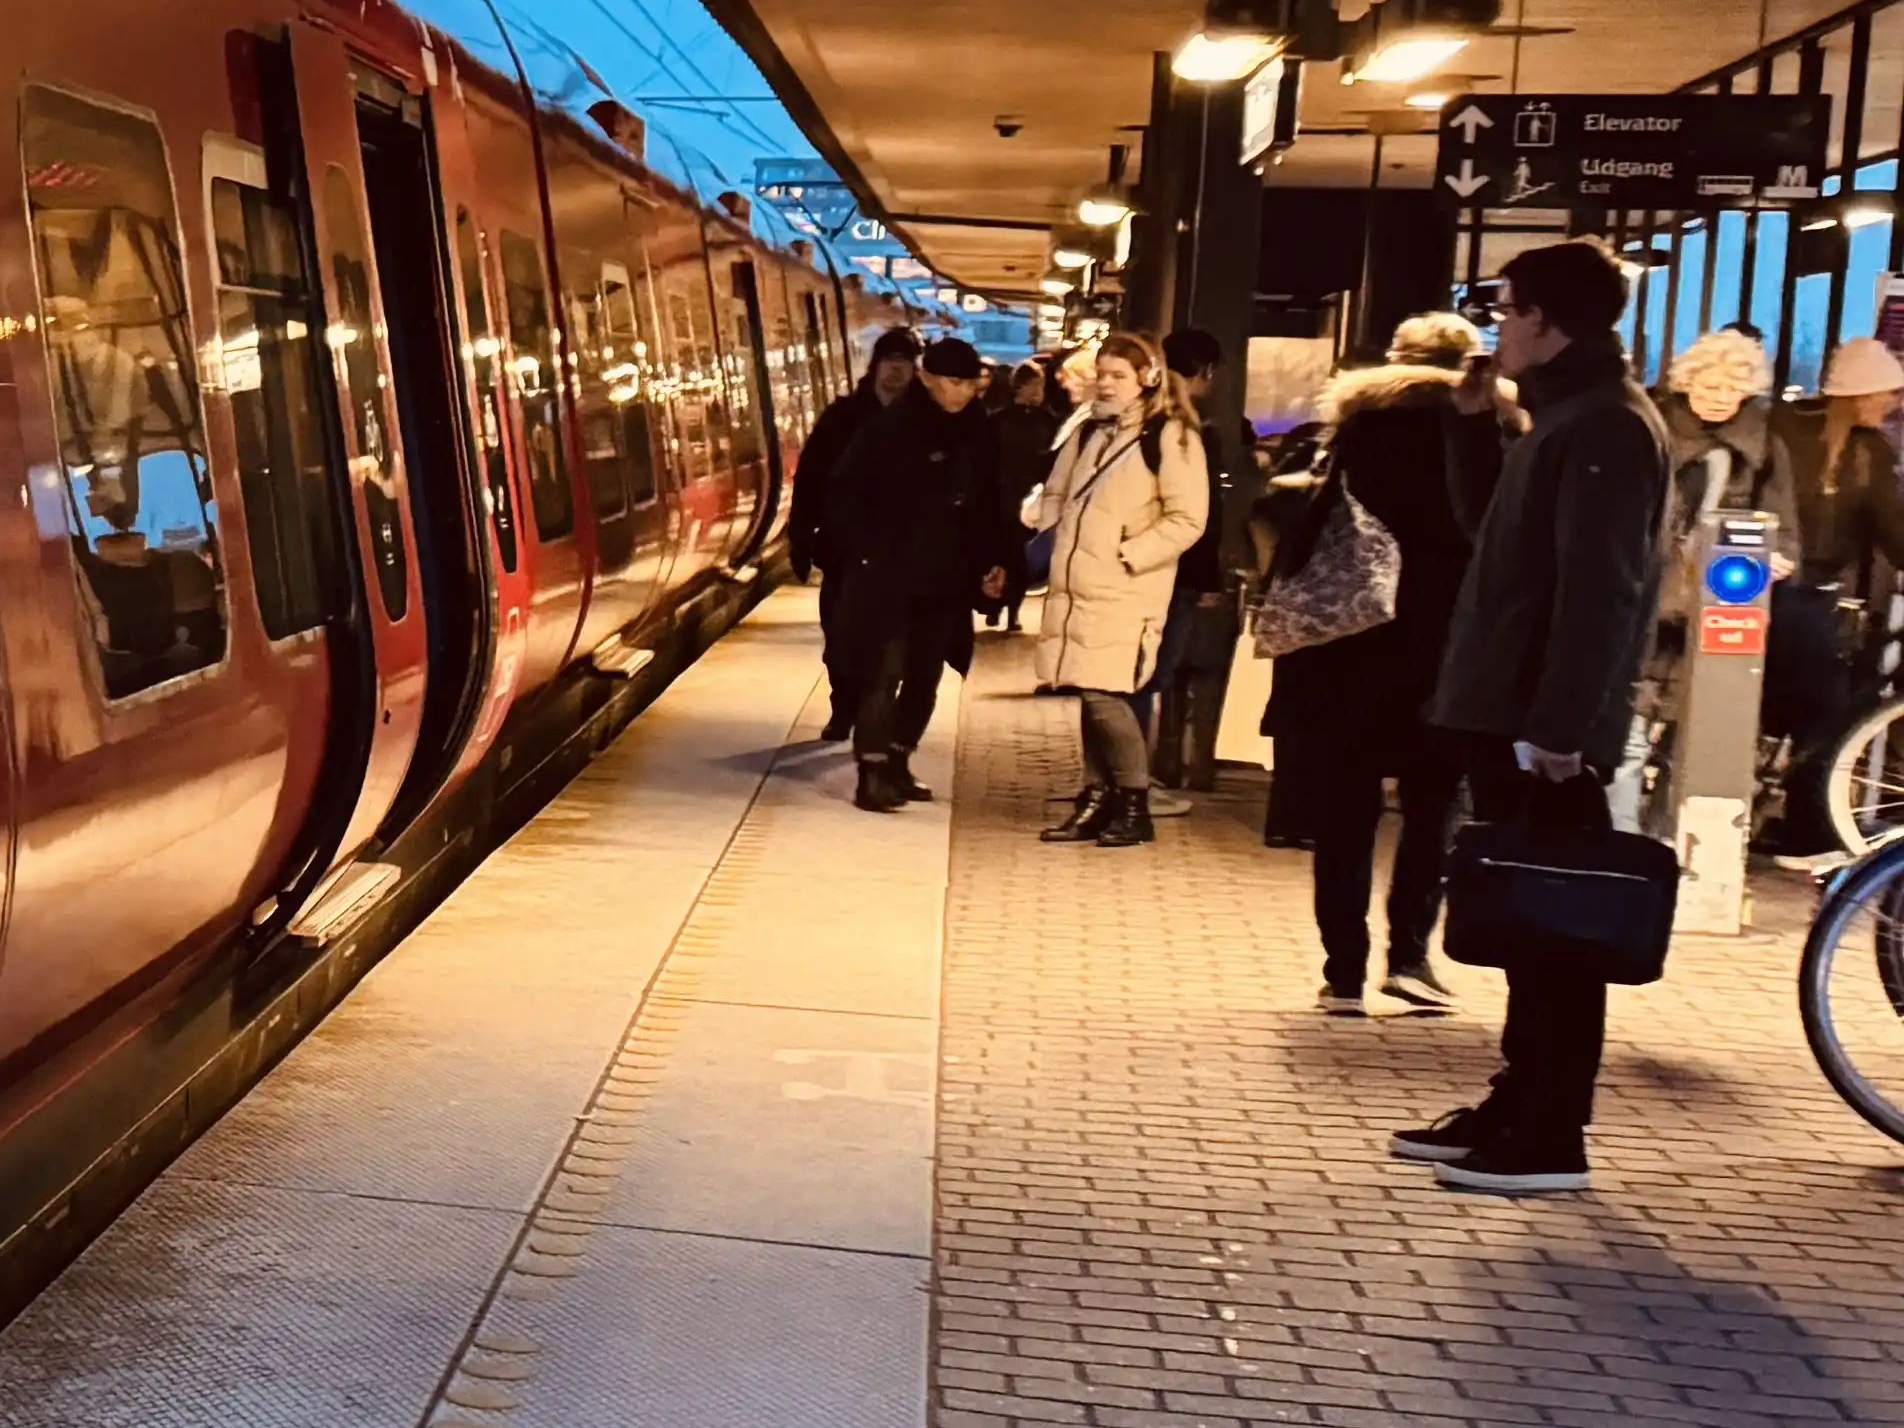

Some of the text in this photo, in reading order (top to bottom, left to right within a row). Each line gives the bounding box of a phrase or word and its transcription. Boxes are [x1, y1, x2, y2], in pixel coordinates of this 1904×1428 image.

[1583, 113, 1683, 132] Elevator
[1579, 158, 1675, 178] Udgang
[1777, 165, 1808, 187] M
[1579, 180, 1612, 194] Exit
